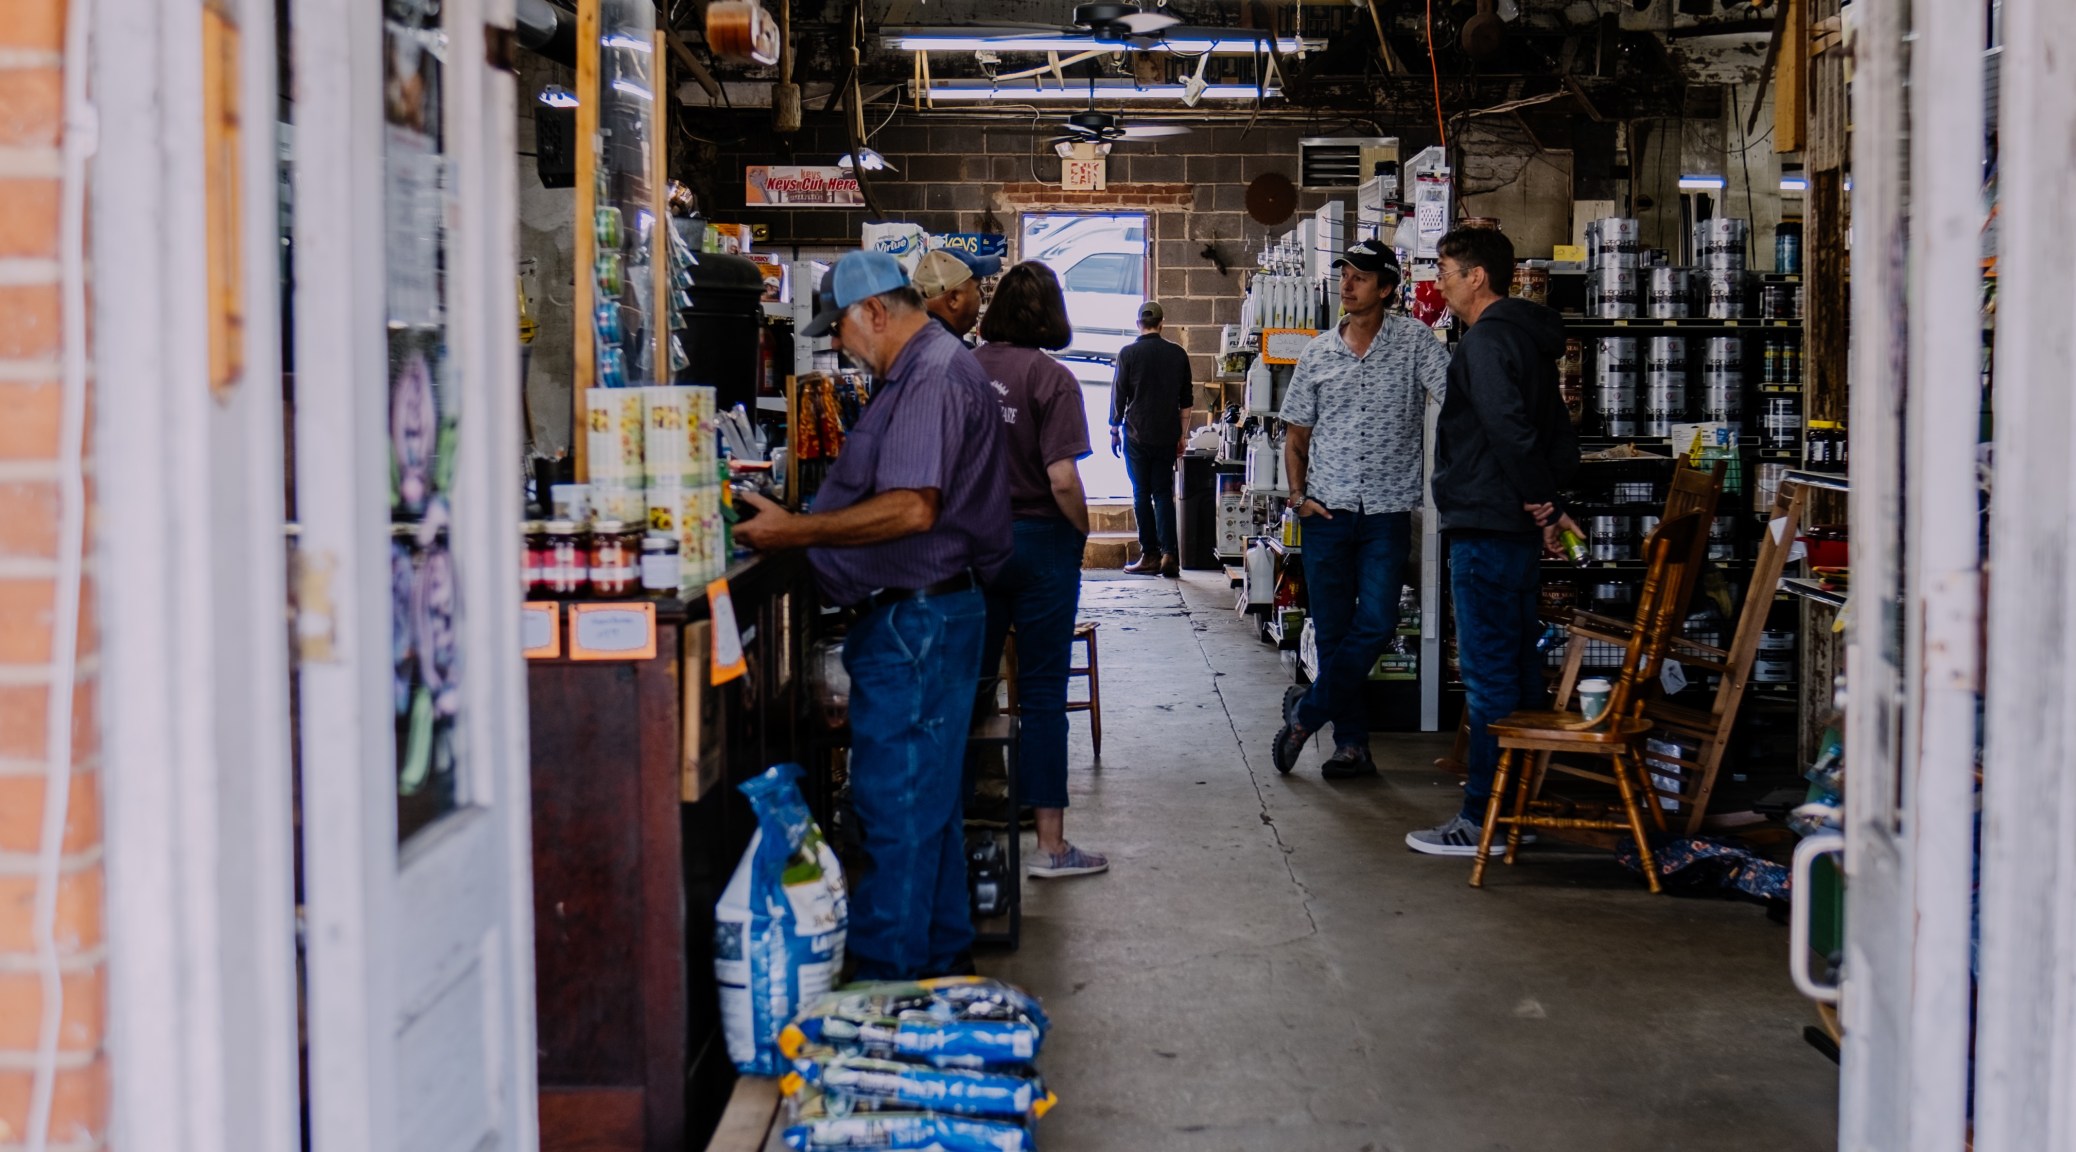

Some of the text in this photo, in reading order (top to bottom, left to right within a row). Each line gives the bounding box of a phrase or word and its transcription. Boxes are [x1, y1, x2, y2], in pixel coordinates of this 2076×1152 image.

[767, 178, 797, 191] Keys
[801, 178, 824, 190] Cut
[874, 238, 907, 252] Virtue
